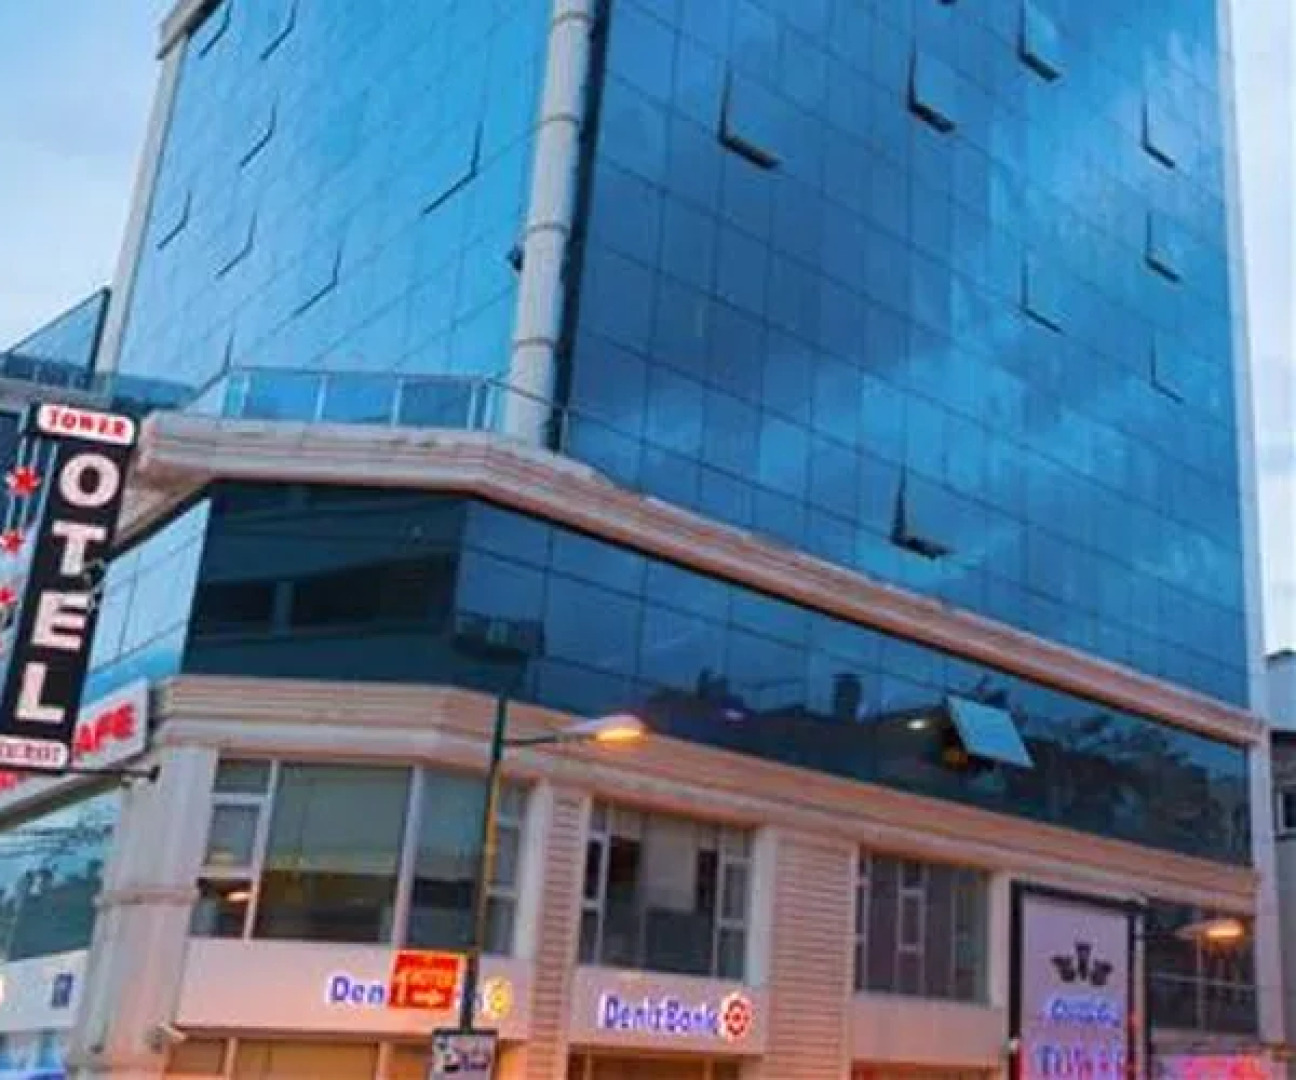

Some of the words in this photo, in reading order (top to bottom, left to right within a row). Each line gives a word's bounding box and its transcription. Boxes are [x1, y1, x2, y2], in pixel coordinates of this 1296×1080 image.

[46, 407, 126, 437] TOWER
[13, 452, 120, 723] OTEL
[74, 699, 138, 758] AFE
